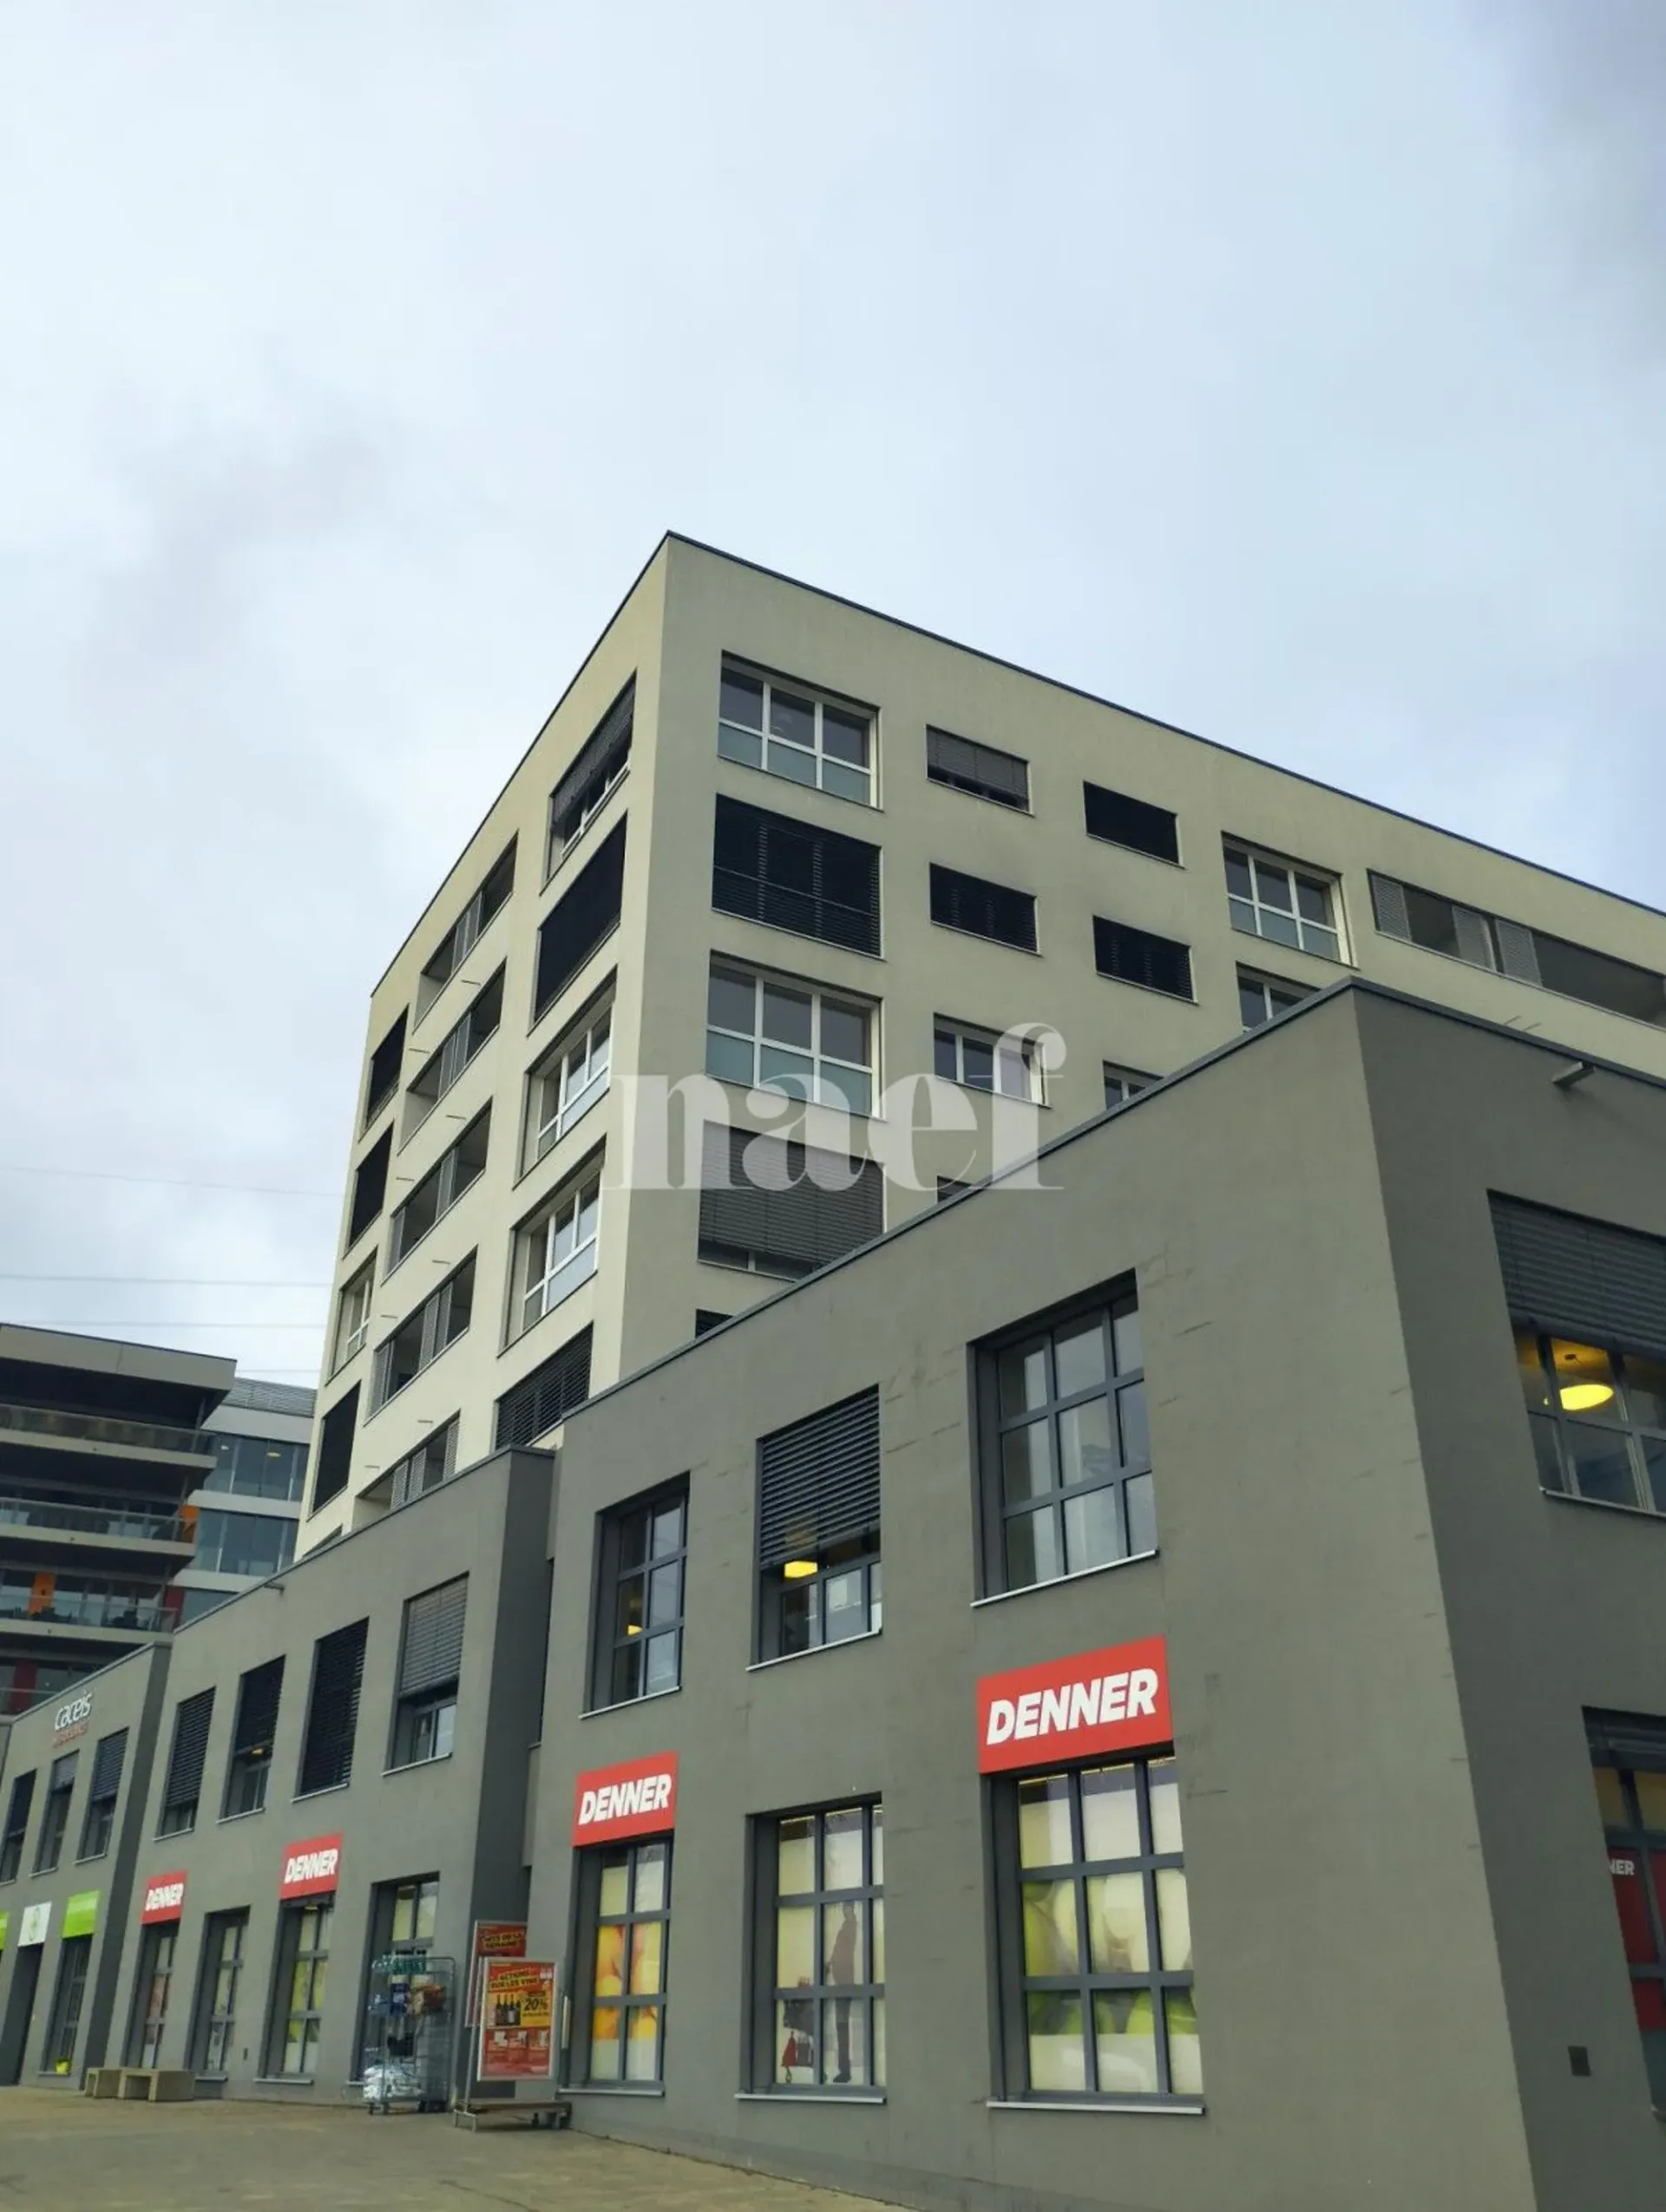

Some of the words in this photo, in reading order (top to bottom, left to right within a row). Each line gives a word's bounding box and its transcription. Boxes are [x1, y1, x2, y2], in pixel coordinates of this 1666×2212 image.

[987, 1668, 1158, 1745] DENNER
[578, 1773, 672, 1825] DENNER
[284, 1849, 338, 1884] DENNER
[145, 1883, 184, 1911] DENNER
[523, 1998, 548, 2011] 20%
